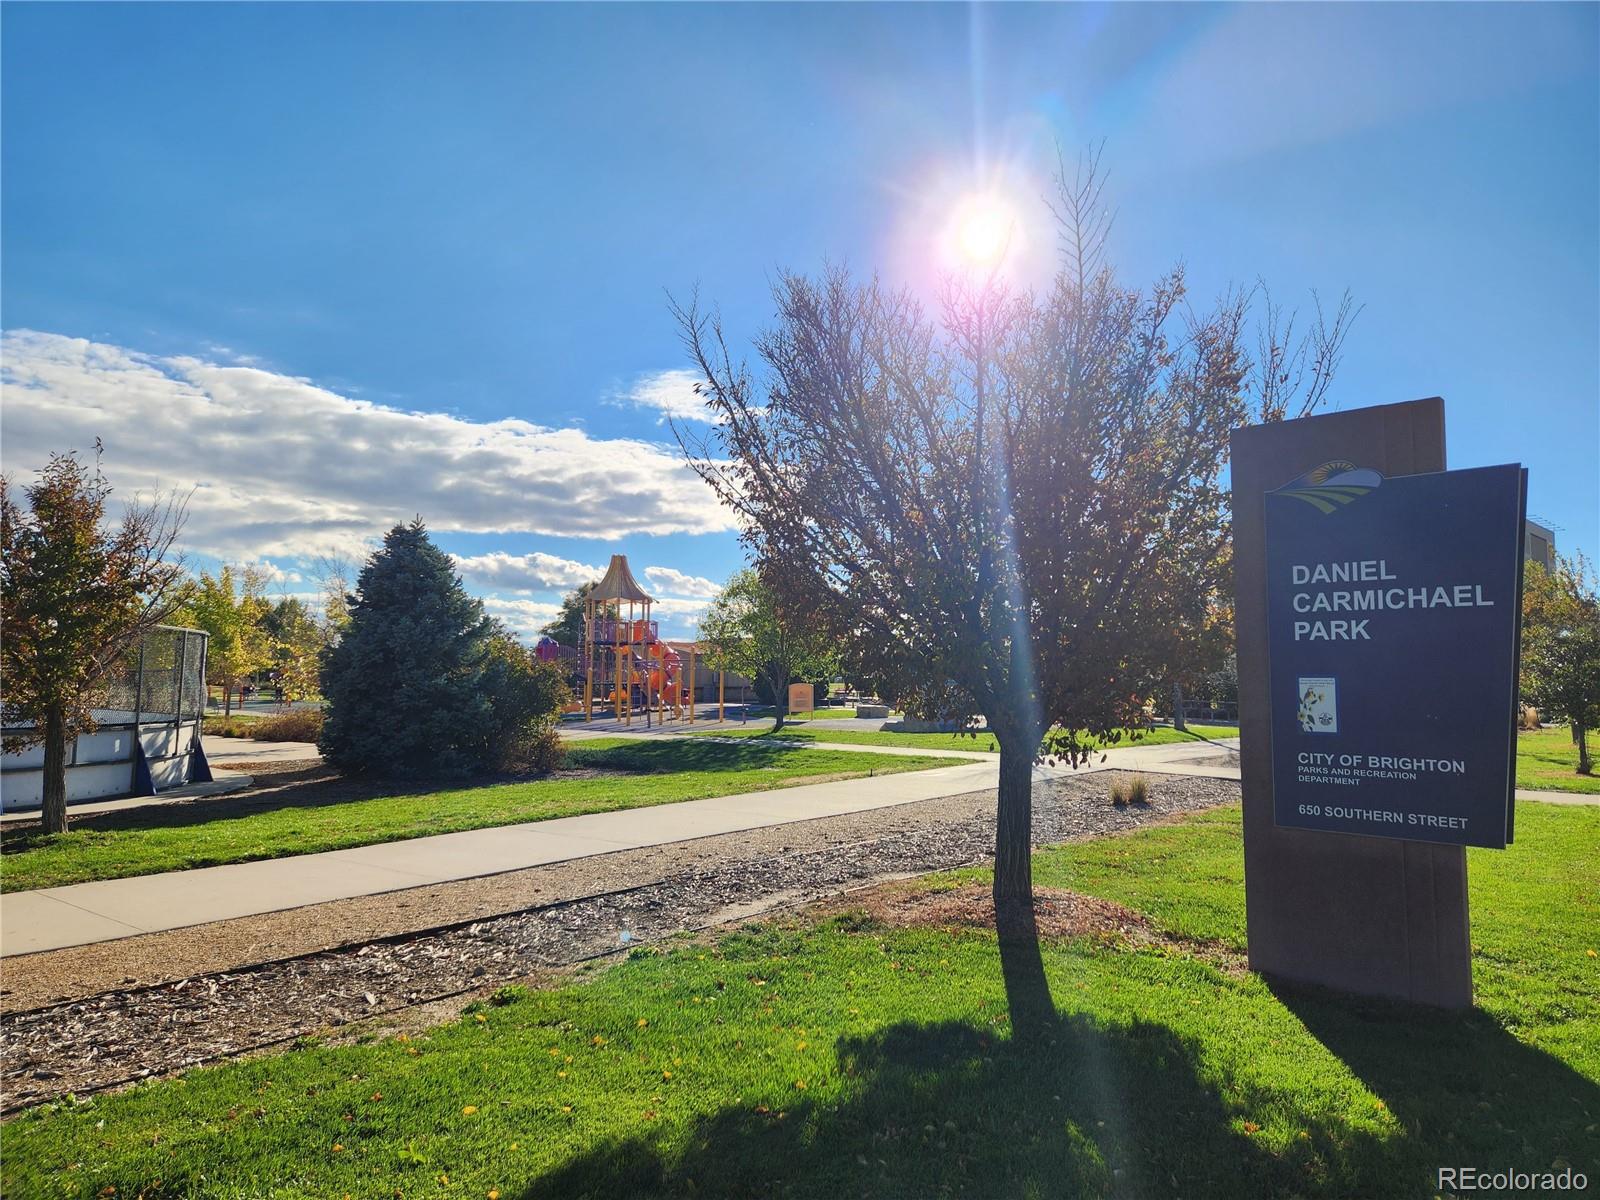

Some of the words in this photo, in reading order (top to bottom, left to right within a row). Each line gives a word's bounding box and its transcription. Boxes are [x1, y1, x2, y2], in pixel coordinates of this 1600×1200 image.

[1292, 560, 1396, 584] DANIEL
[1293, 585, 1494, 613] CARMICHAEL
[1294, 620, 1371, 641] PARK
[1297, 752, 1335, 766] CITY
[1339, 754, 1362, 767] OF
[1368, 756, 1466, 773] BRIGHTON
[1298, 766, 1329, 775] PARKS
[1331, 768, 1351, 776] AND
[1353, 769, 1417, 780] RECREATION
[1298, 775, 1361, 786] DEPARTMENT
[1299, 804, 1321, 817] 650
[1324, 806, 1404, 823] SOUTHERN
[1408, 814, 1469, 830] STREET
